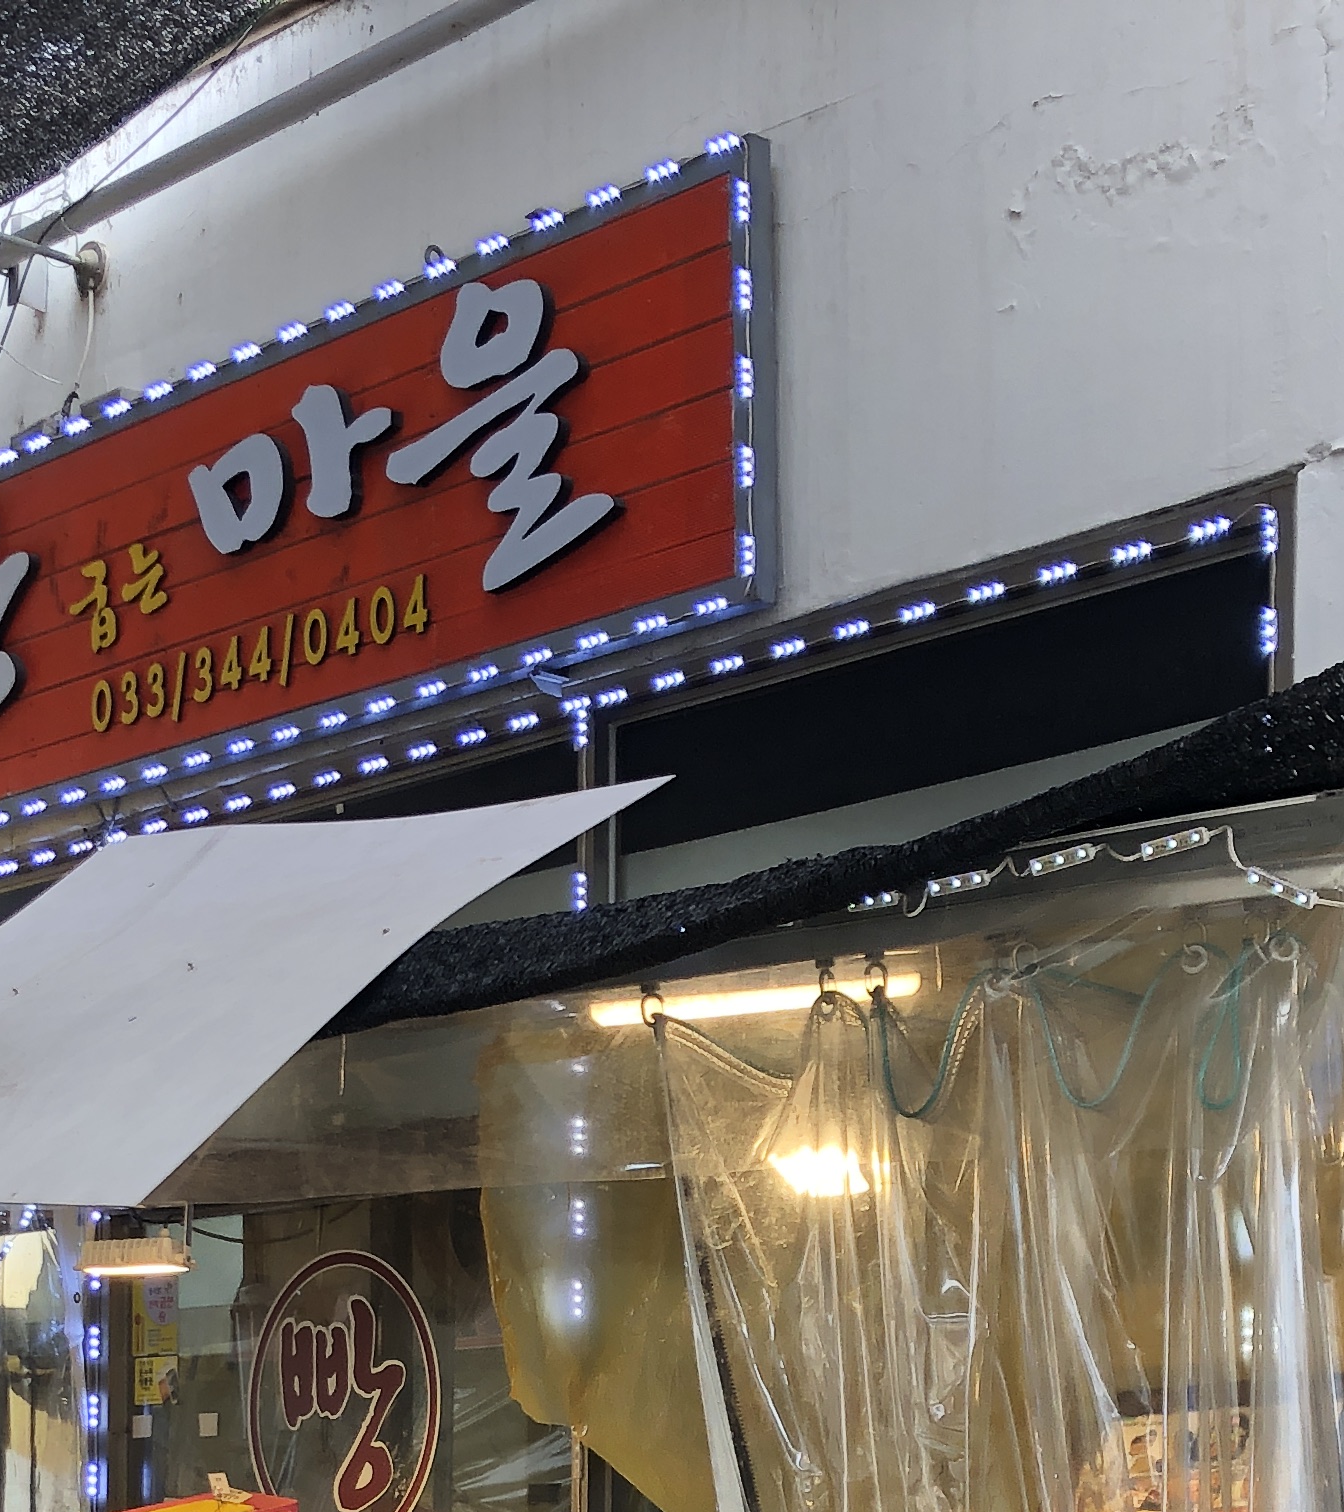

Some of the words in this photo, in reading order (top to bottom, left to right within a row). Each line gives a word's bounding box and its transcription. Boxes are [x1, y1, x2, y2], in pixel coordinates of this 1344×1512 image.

[69, 543, 168, 654] 굽는
[187, 278, 615, 592] 마을
[90, 574, 428, 732] 033/344/0404
